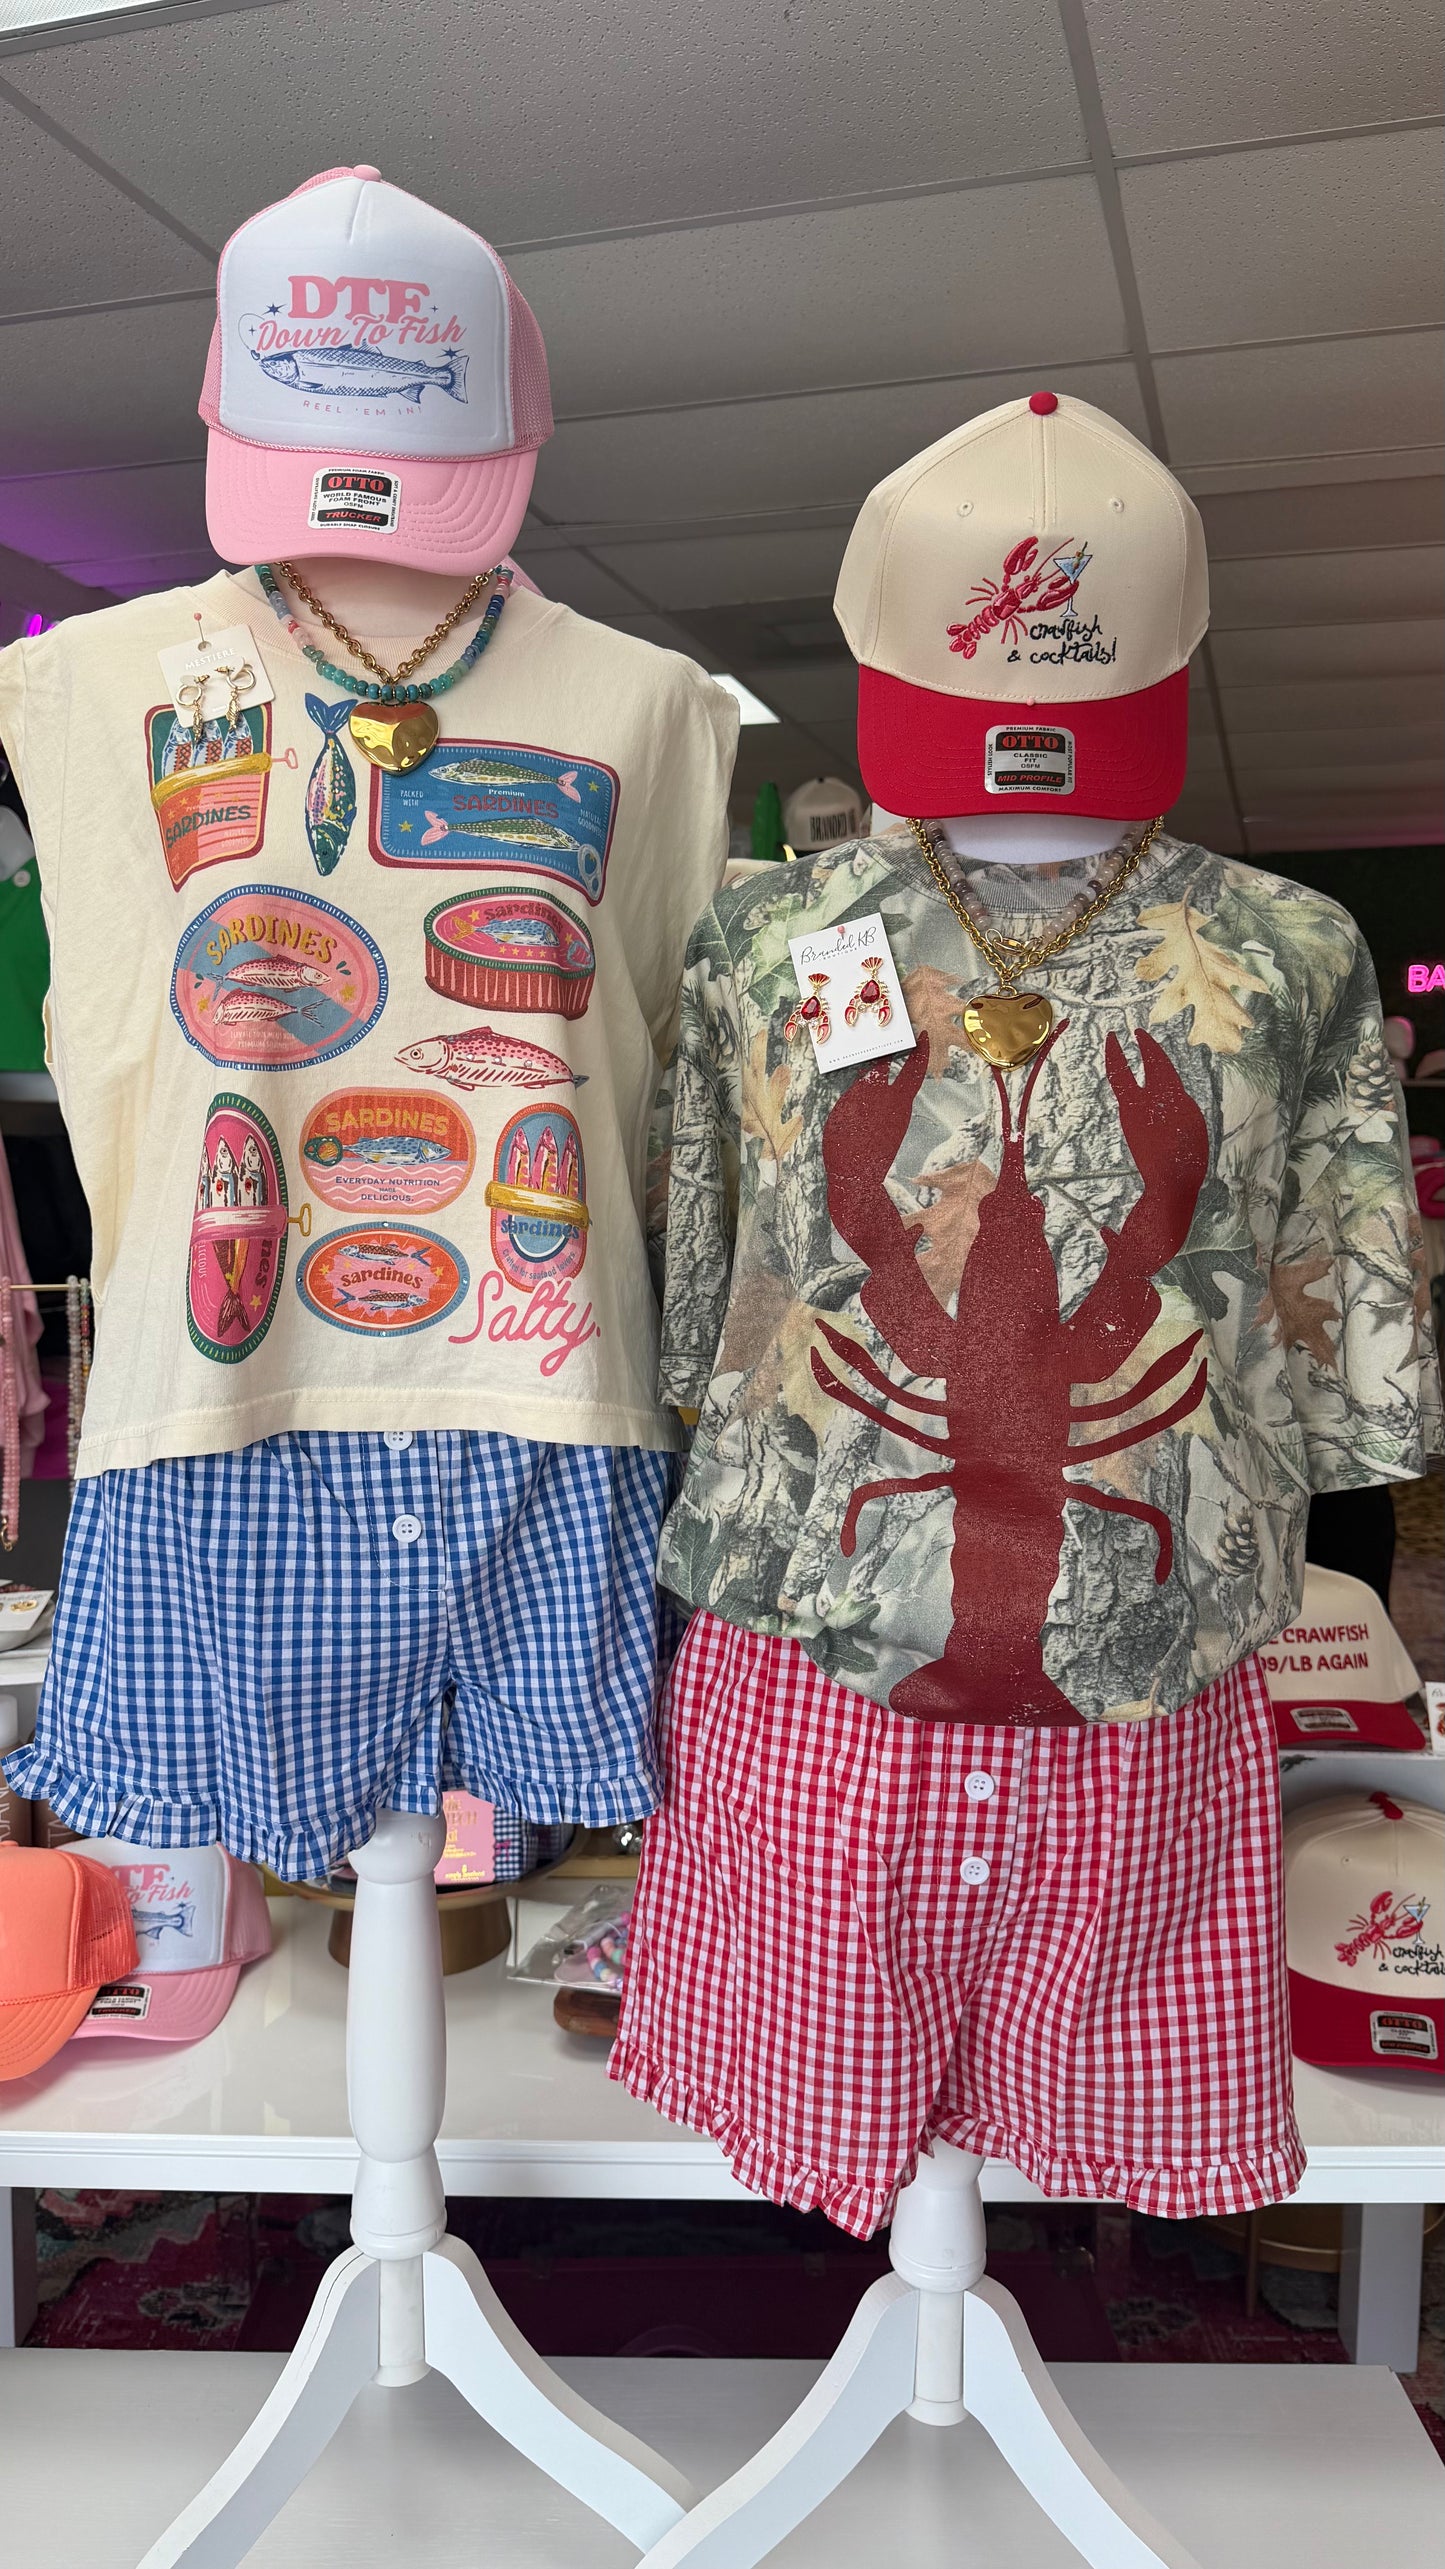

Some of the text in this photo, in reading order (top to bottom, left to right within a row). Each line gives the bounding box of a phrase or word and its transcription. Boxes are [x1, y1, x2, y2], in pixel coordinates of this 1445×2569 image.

[288, 276, 431, 324] DTF
[256, 314, 467, 351] Down To Fish
[303, 401, 342, 413] REEL
[328, 476, 384, 492] OTTO
[352, 498, 380, 506] FRONT
[353, 492, 387, 503] FAMOUS
[325, 511, 382, 523] TRUCKER
[1029, 614, 1103, 642] crawfish
[185, 648, 238, 670] MESTIERE
[1007, 637, 1117, 665] & cocktails!
[1002, 735, 1059, 749] OTTO
[997, 774, 1063, 783] MID PROFILE
[400, 789, 424, 799] PACKED
[402, 798, 419, 807] WITH
[488, 788, 525, 797] Premium
[452, 795, 559, 819] SARDINES
[165, 804, 252, 849] SARDINES
[206, 913, 338, 966] SARDINES
[801, 926, 877, 965] Branded KB
[325, 1107, 450, 1136] SARDINES
[335, 1176, 440, 1187] EVERYDAY NUTRITION
[361, 1193, 415, 1202] DELICIOUS.
[500, 1219, 580, 1239] sardines
[341, 1266, 424, 1289] sardines
[448, 1270, 601, 1377] Salty.
[1282, 1623, 1369, 1645] CRAWFISH
[1317, 1652, 1369, 1671] AGAIN
[111, 1863, 171, 1891] TF
[147, 1880, 195, 1904] Fish
